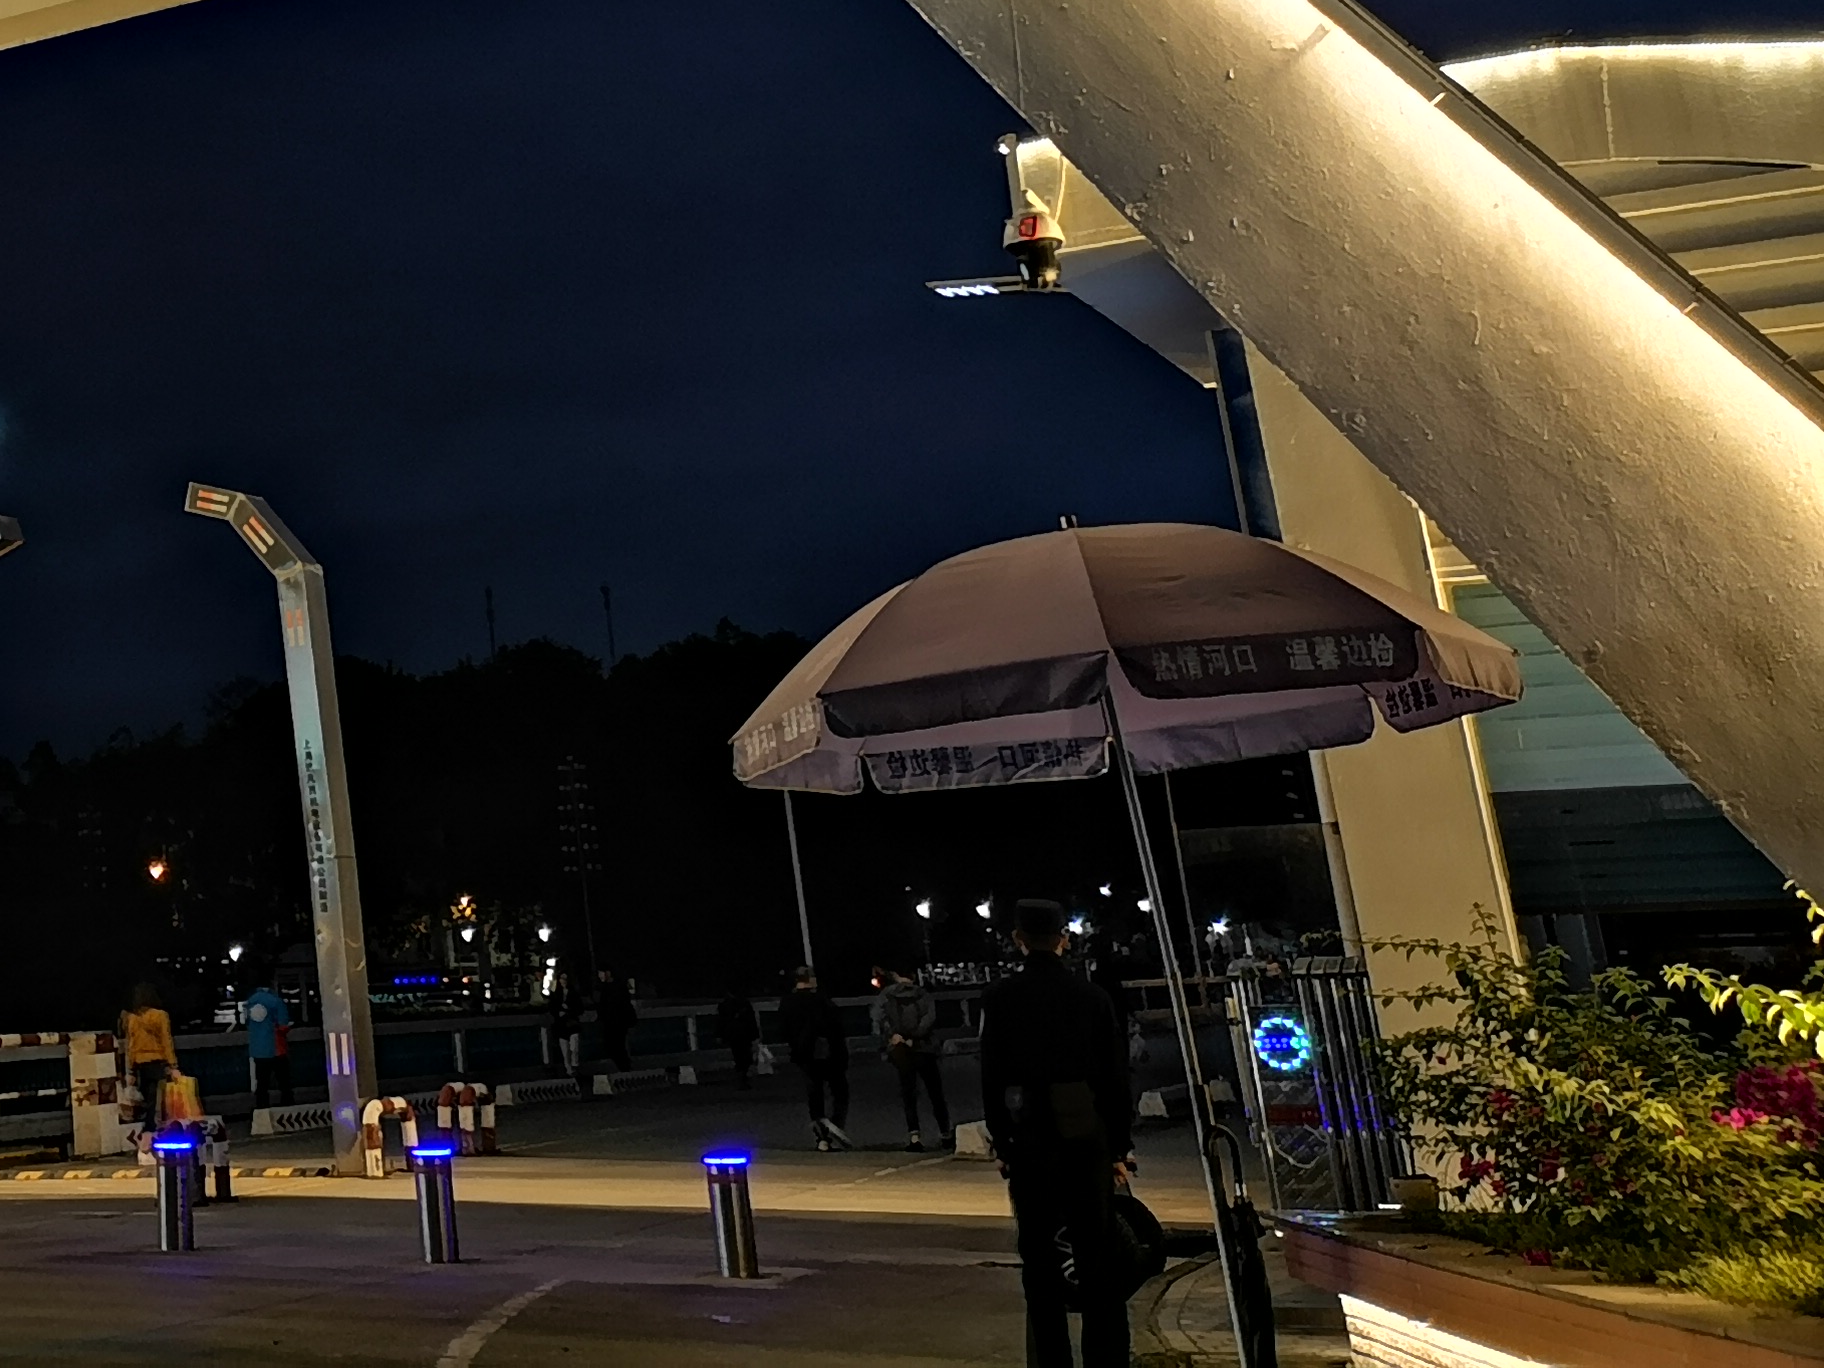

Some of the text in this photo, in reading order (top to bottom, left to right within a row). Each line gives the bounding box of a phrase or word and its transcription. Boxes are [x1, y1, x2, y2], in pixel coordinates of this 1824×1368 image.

[1152, 632, 1394, 682] 热情河口 温馨边检
